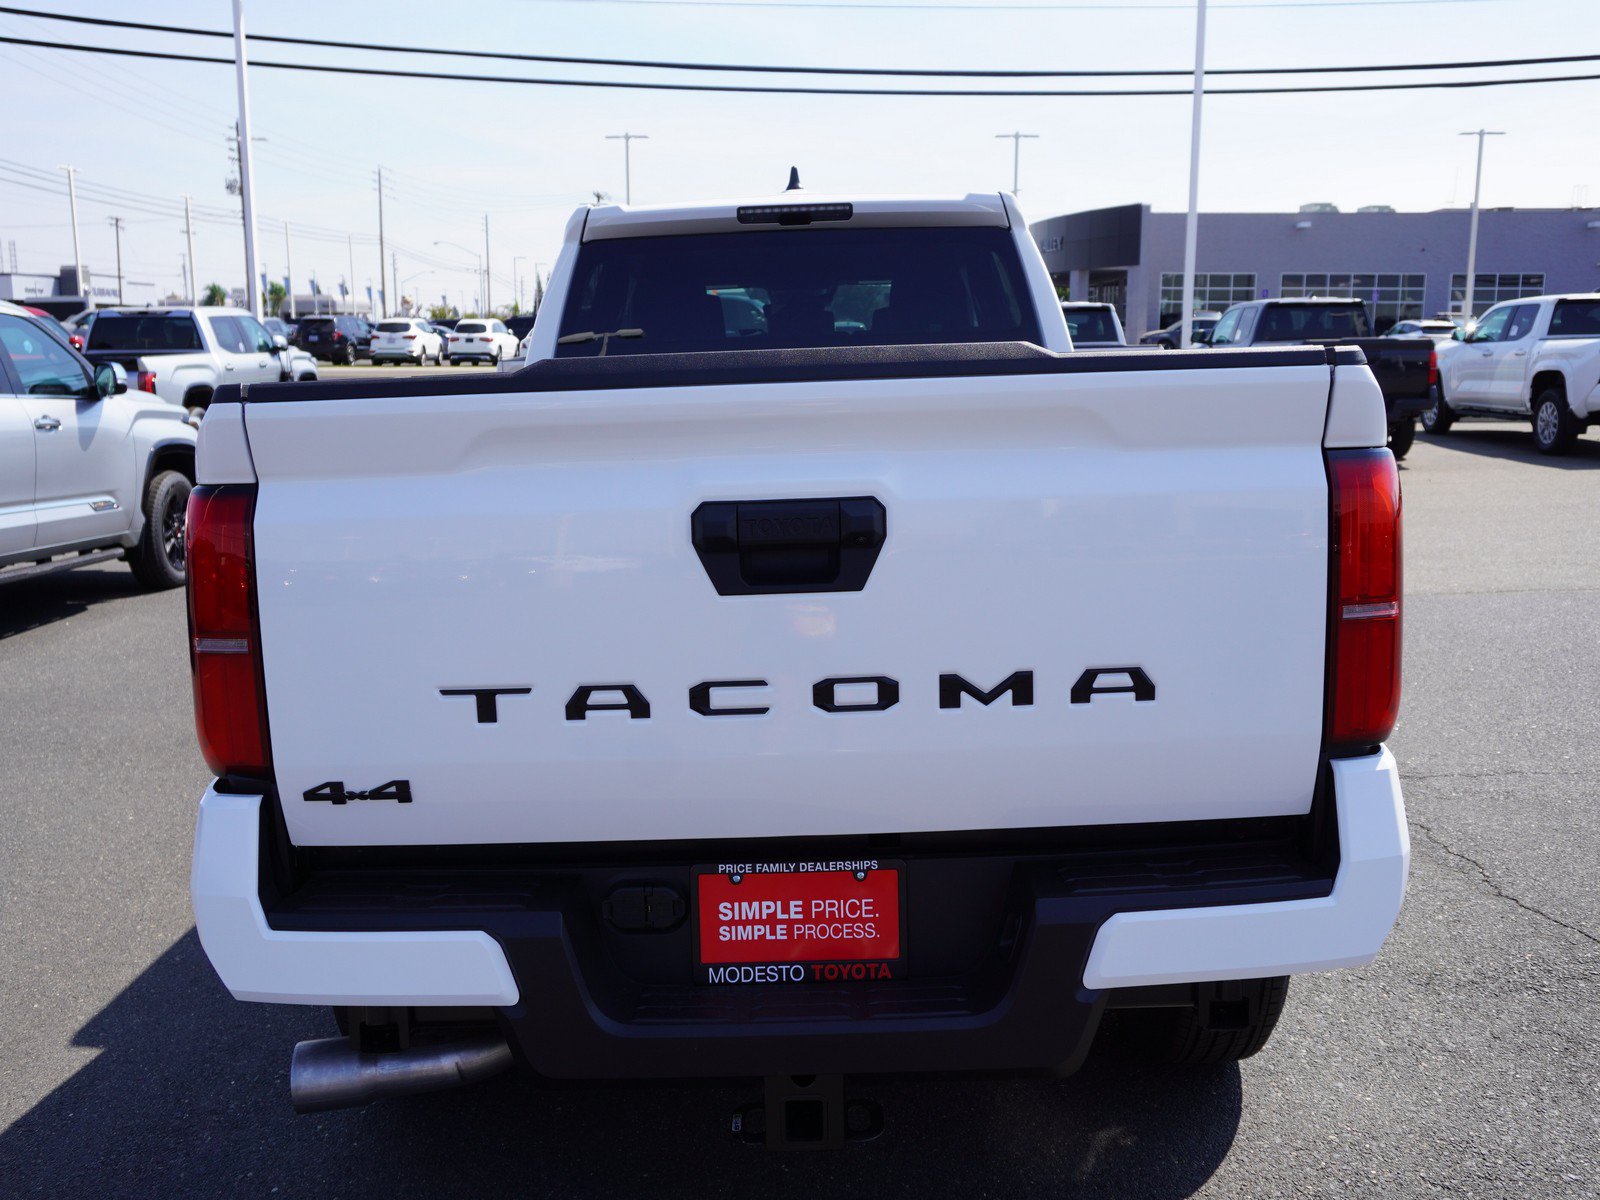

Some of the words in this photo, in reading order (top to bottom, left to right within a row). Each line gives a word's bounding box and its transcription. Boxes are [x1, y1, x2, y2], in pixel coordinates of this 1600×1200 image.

[1038, 235, 1064, 253] ALLEY
[743, 516, 833, 537] TOYOTA
[438, 665, 1156, 724] TACOMA
[303, 780, 412, 805] 4x4
[718, 864, 752, 874] PRICE
[755, 863, 796, 873] FAMILY
[799, 860, 879, 872] DEALERSHIPS
[718, 901, 804, 921] SIMPLE
[811, 899, 880, 919] PRICE.
[719, 925, 788, 941] SIMPLE
[793, 923, 880, 940] PROCESS.
[708, 965, 805, 984] MODESTO
[811, 963, 892, 981] TOYOTA
